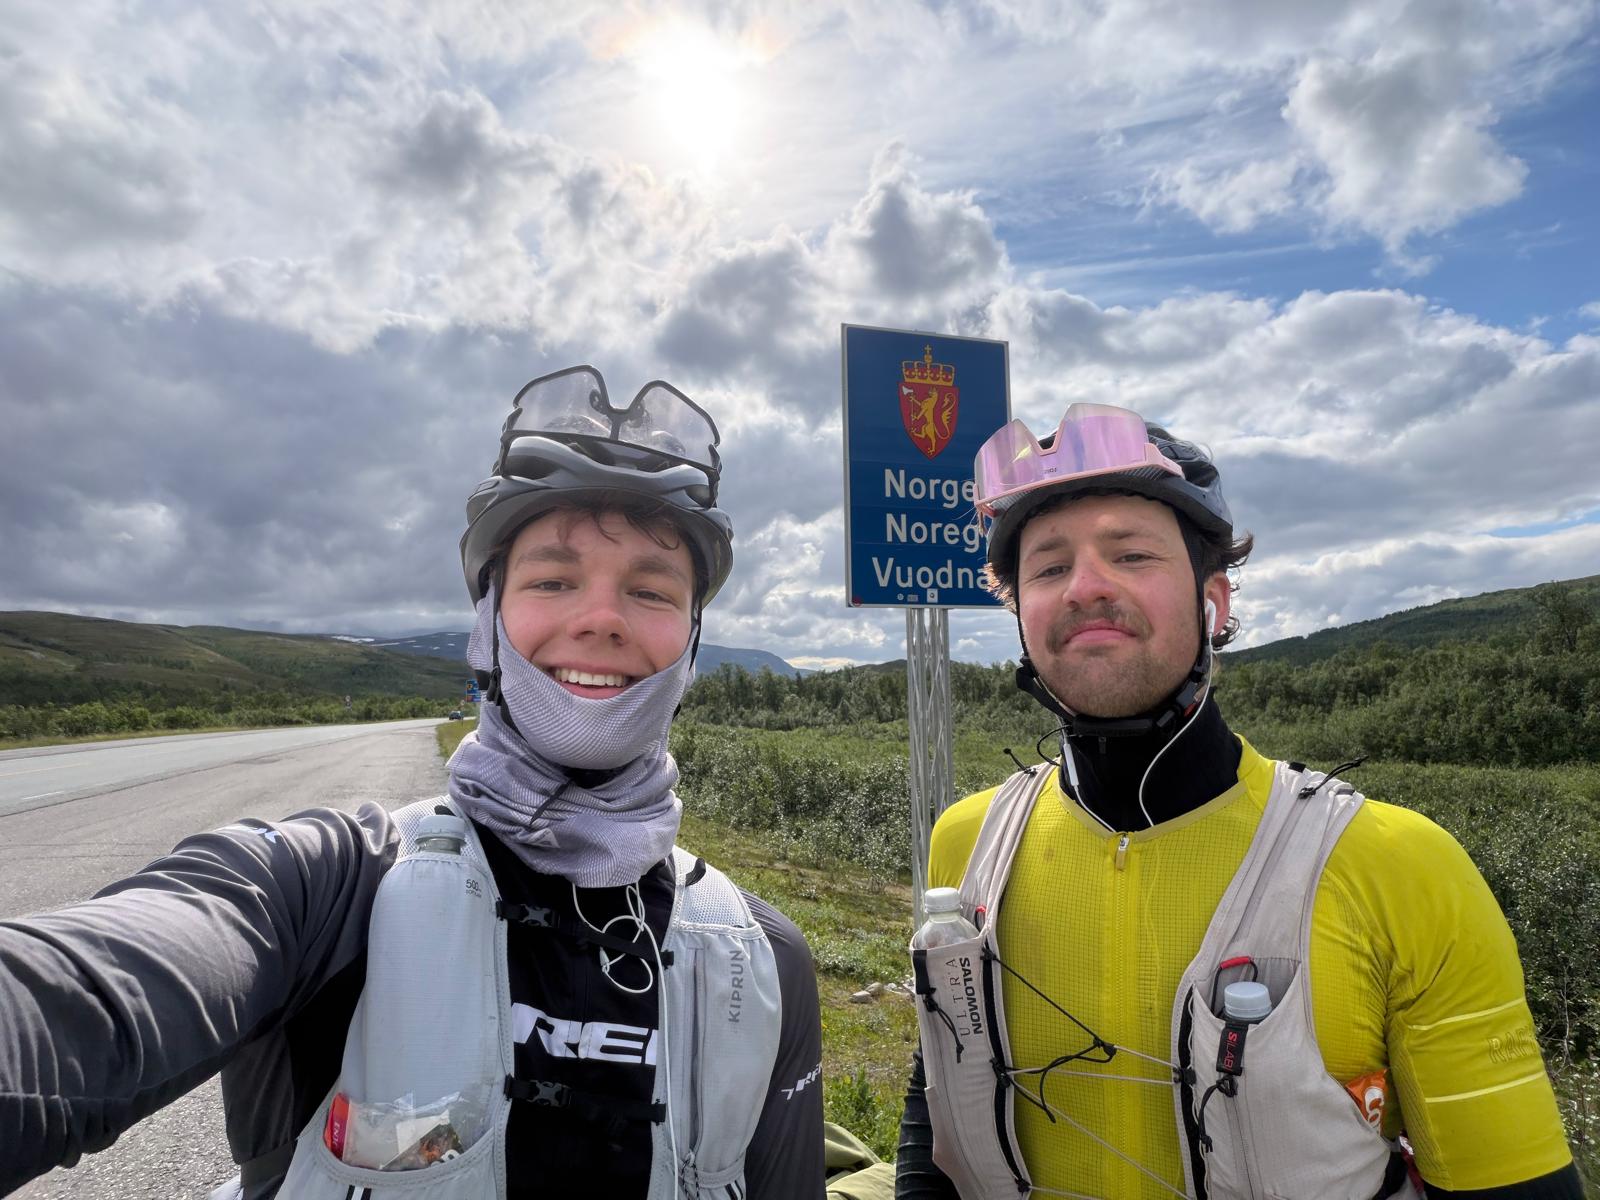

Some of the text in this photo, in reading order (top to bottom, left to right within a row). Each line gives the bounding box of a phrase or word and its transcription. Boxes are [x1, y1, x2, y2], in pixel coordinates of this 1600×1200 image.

[884, 468, 974, 509] Norge
[886, 513, 981, 553] Noreg
[871, 557, 989, 589] Vuodna
[728, 949, 744, 1023] KIPRUN
[946, 958, 971, 1037] ULTRA
[959, 957, 984, 1035] SALOMON
